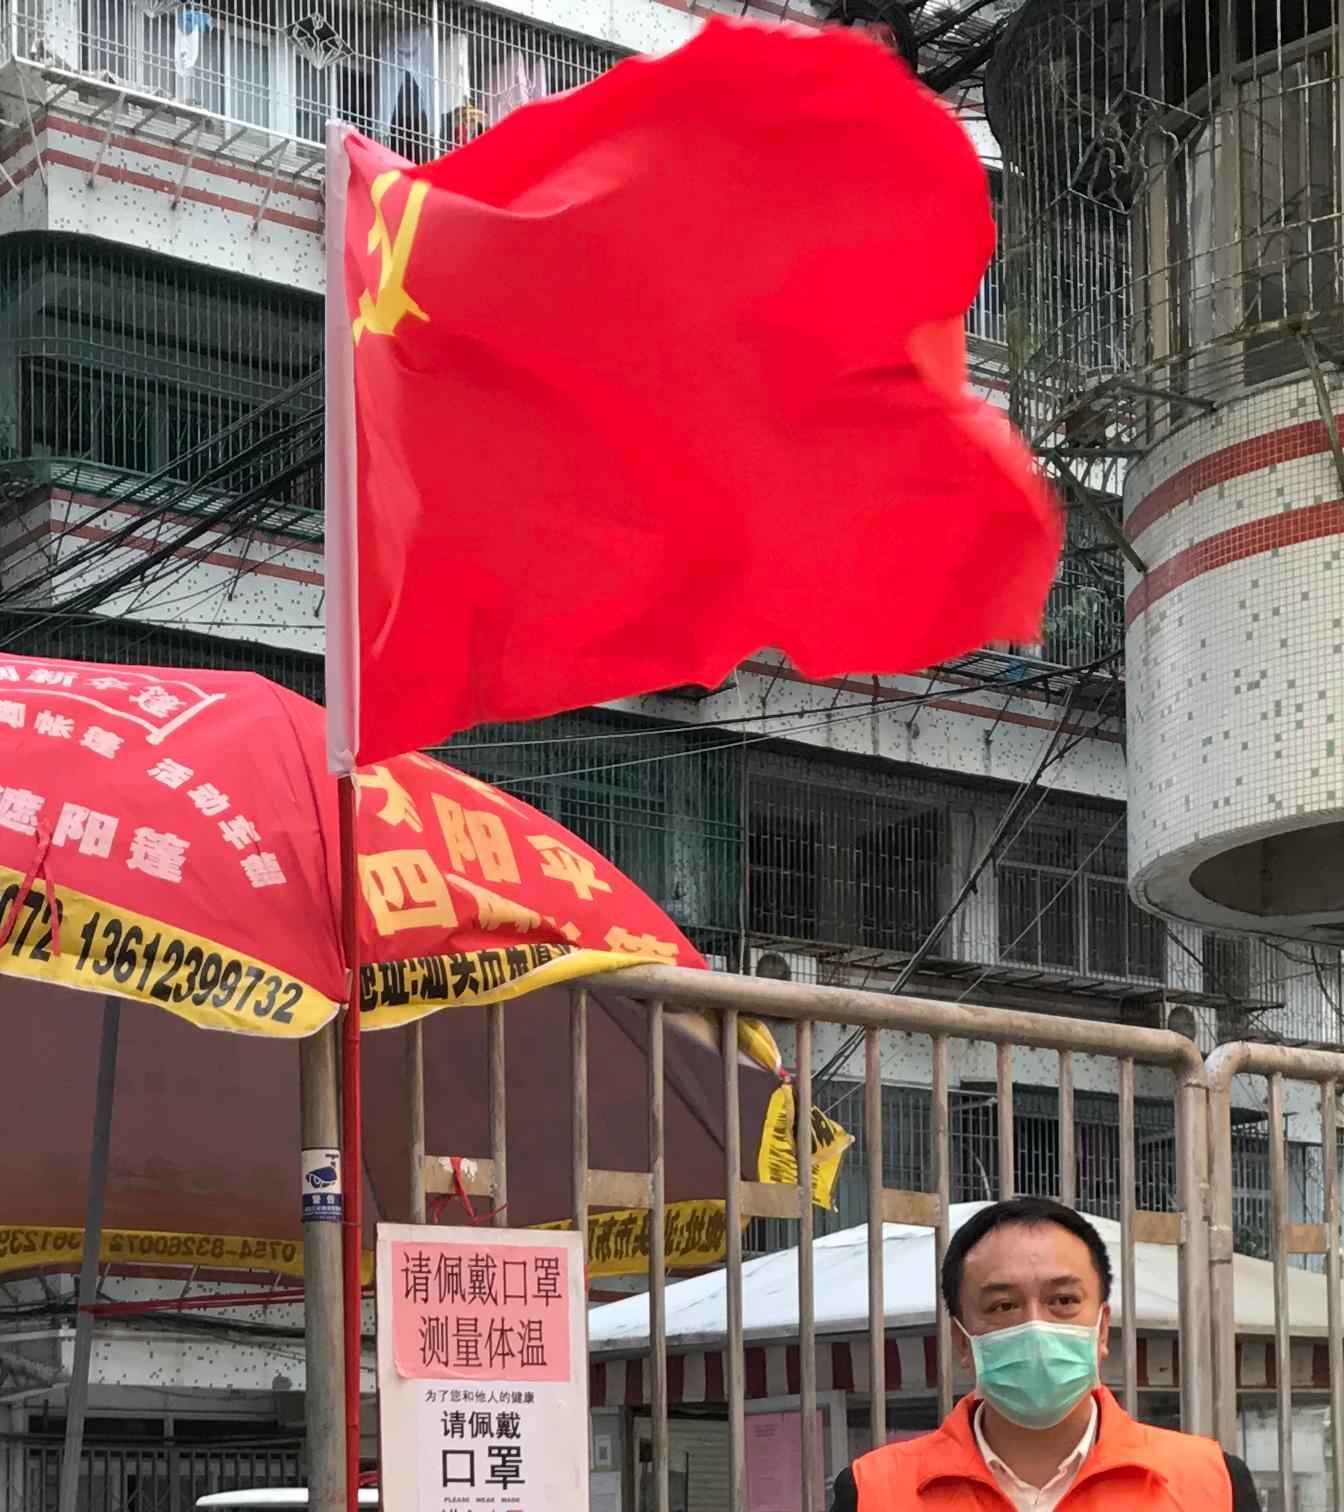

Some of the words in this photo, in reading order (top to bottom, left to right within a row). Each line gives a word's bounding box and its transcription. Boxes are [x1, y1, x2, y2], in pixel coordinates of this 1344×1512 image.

[75, 912, 303, 1024] 13612399732
[401, 1251, 562, 1307] 请佩戴口罩
[419, 1315, 547, 1369] 测量体温
[425, 1389, 535, 1404] 为了您和他人的健康
[441, 1410, 521, 1439] 请佩戴
[442, 1446, 525, 1490] 口罩
